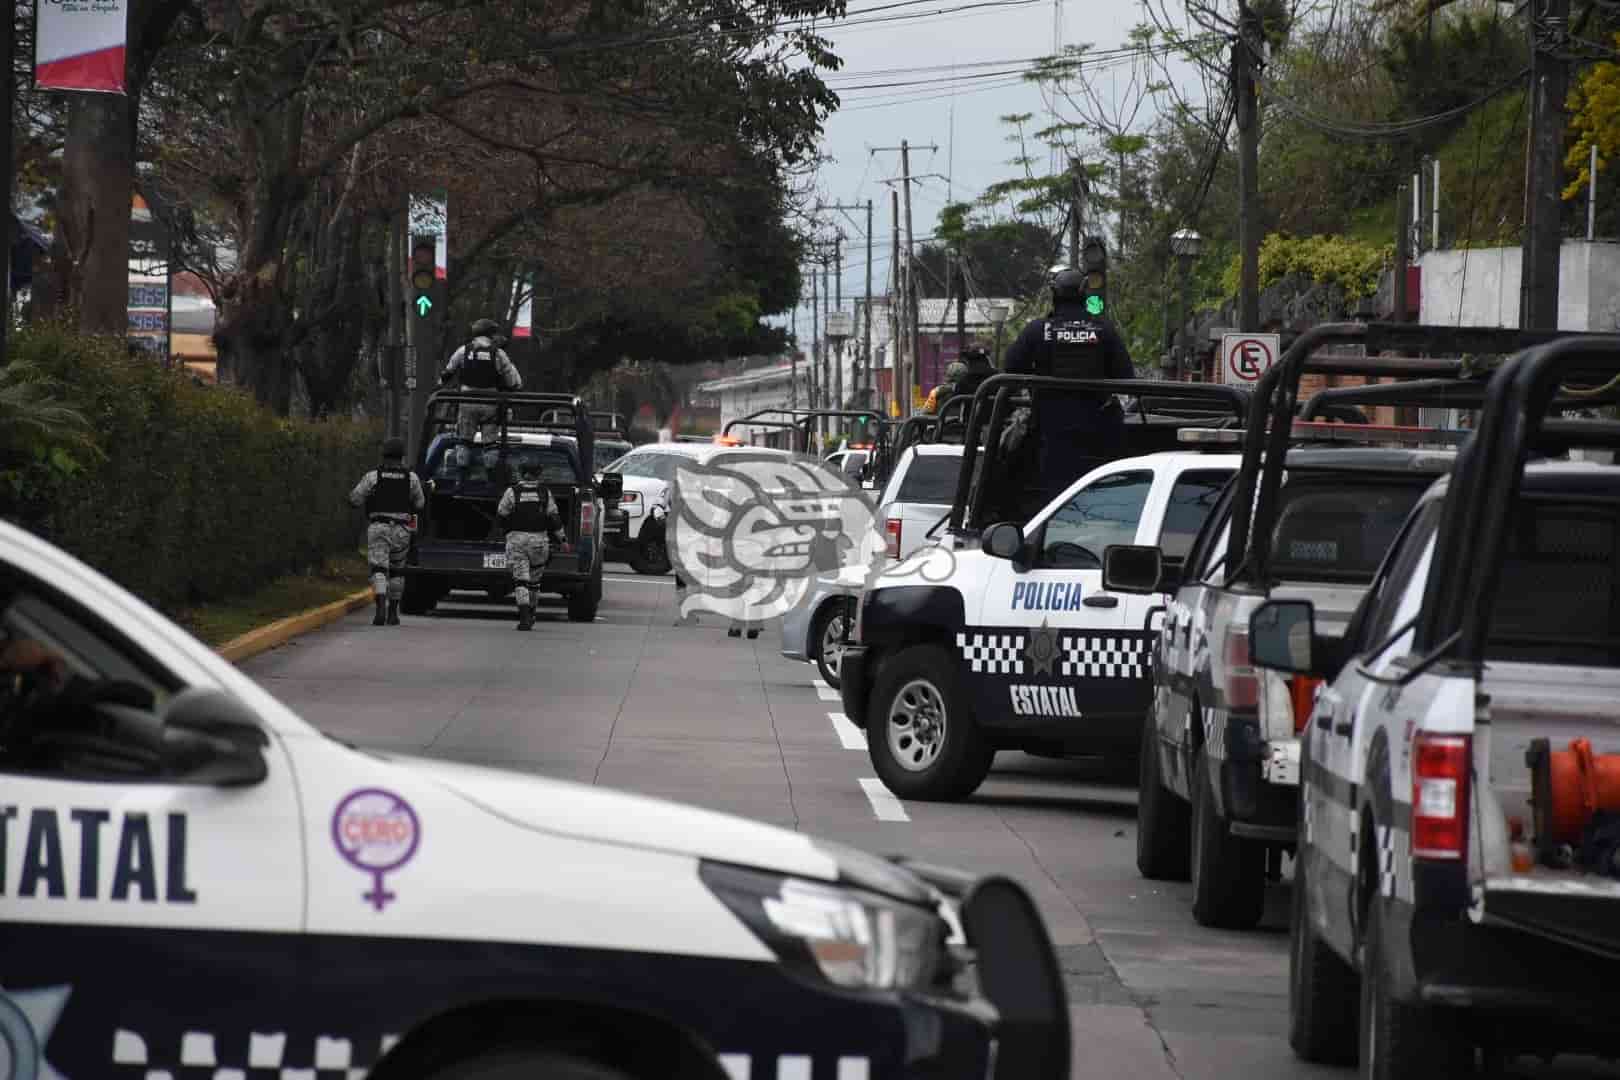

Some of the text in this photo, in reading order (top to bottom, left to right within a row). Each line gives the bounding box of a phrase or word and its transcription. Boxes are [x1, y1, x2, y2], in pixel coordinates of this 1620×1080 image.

[1056, 331, 1097, 341] POLICIA
[1240, 347, 1261, 373] E
[1011, 581, 1082, 611] POLICIA
[1009, 684, 1083, 717] ESTATAL
[343, 814, 410, 843] CERO
